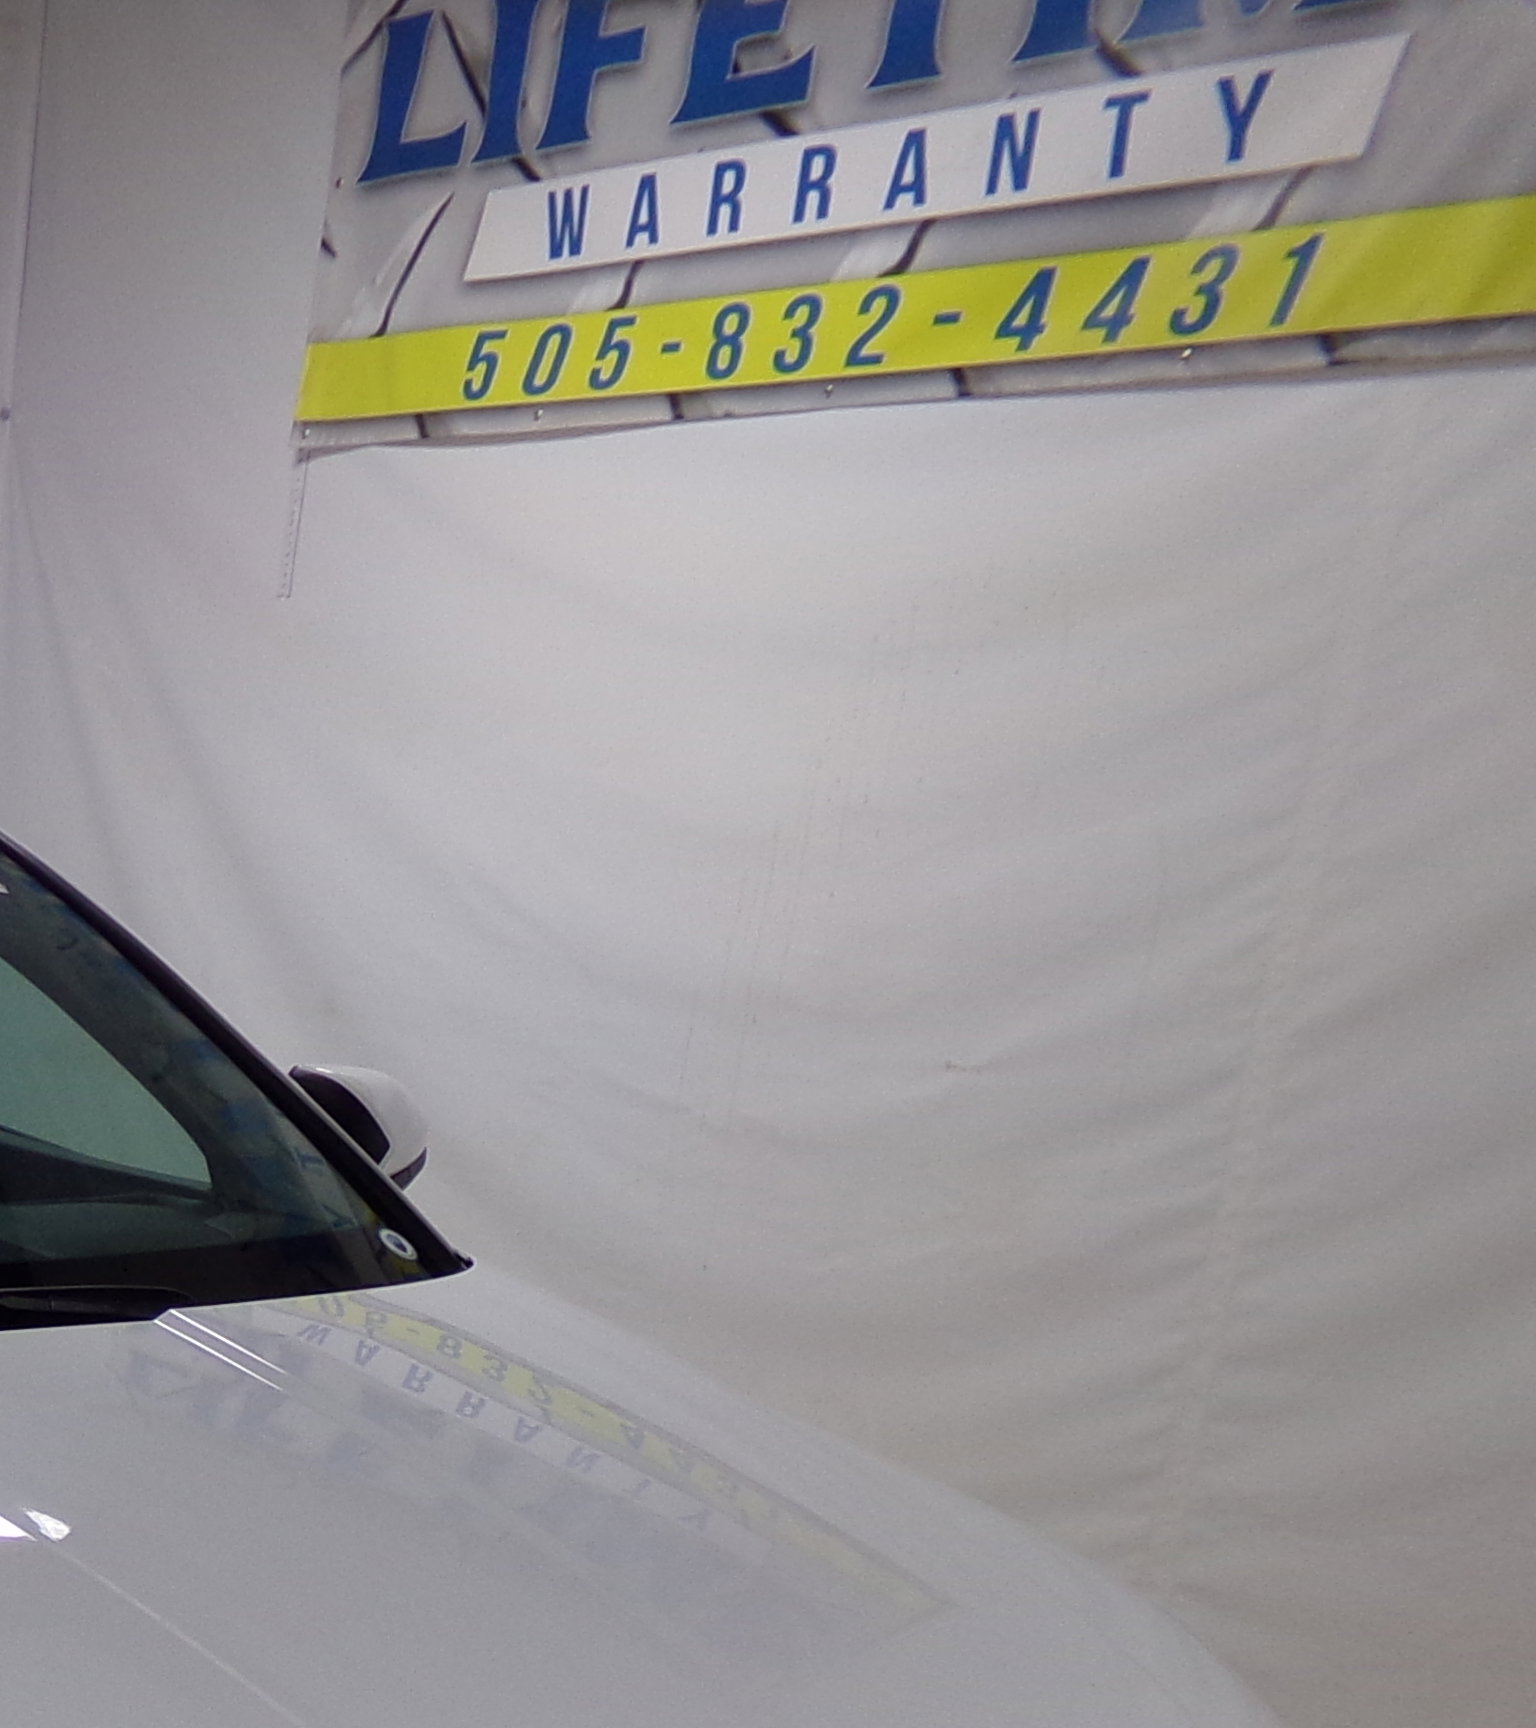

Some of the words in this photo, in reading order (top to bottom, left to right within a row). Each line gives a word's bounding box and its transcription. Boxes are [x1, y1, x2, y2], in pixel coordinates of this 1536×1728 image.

[356, 0, 1390, 183] LIFE
[547, 70, 1275, 259] WARRANTY
[462, 234, 1325, 400] 505-832-4431
